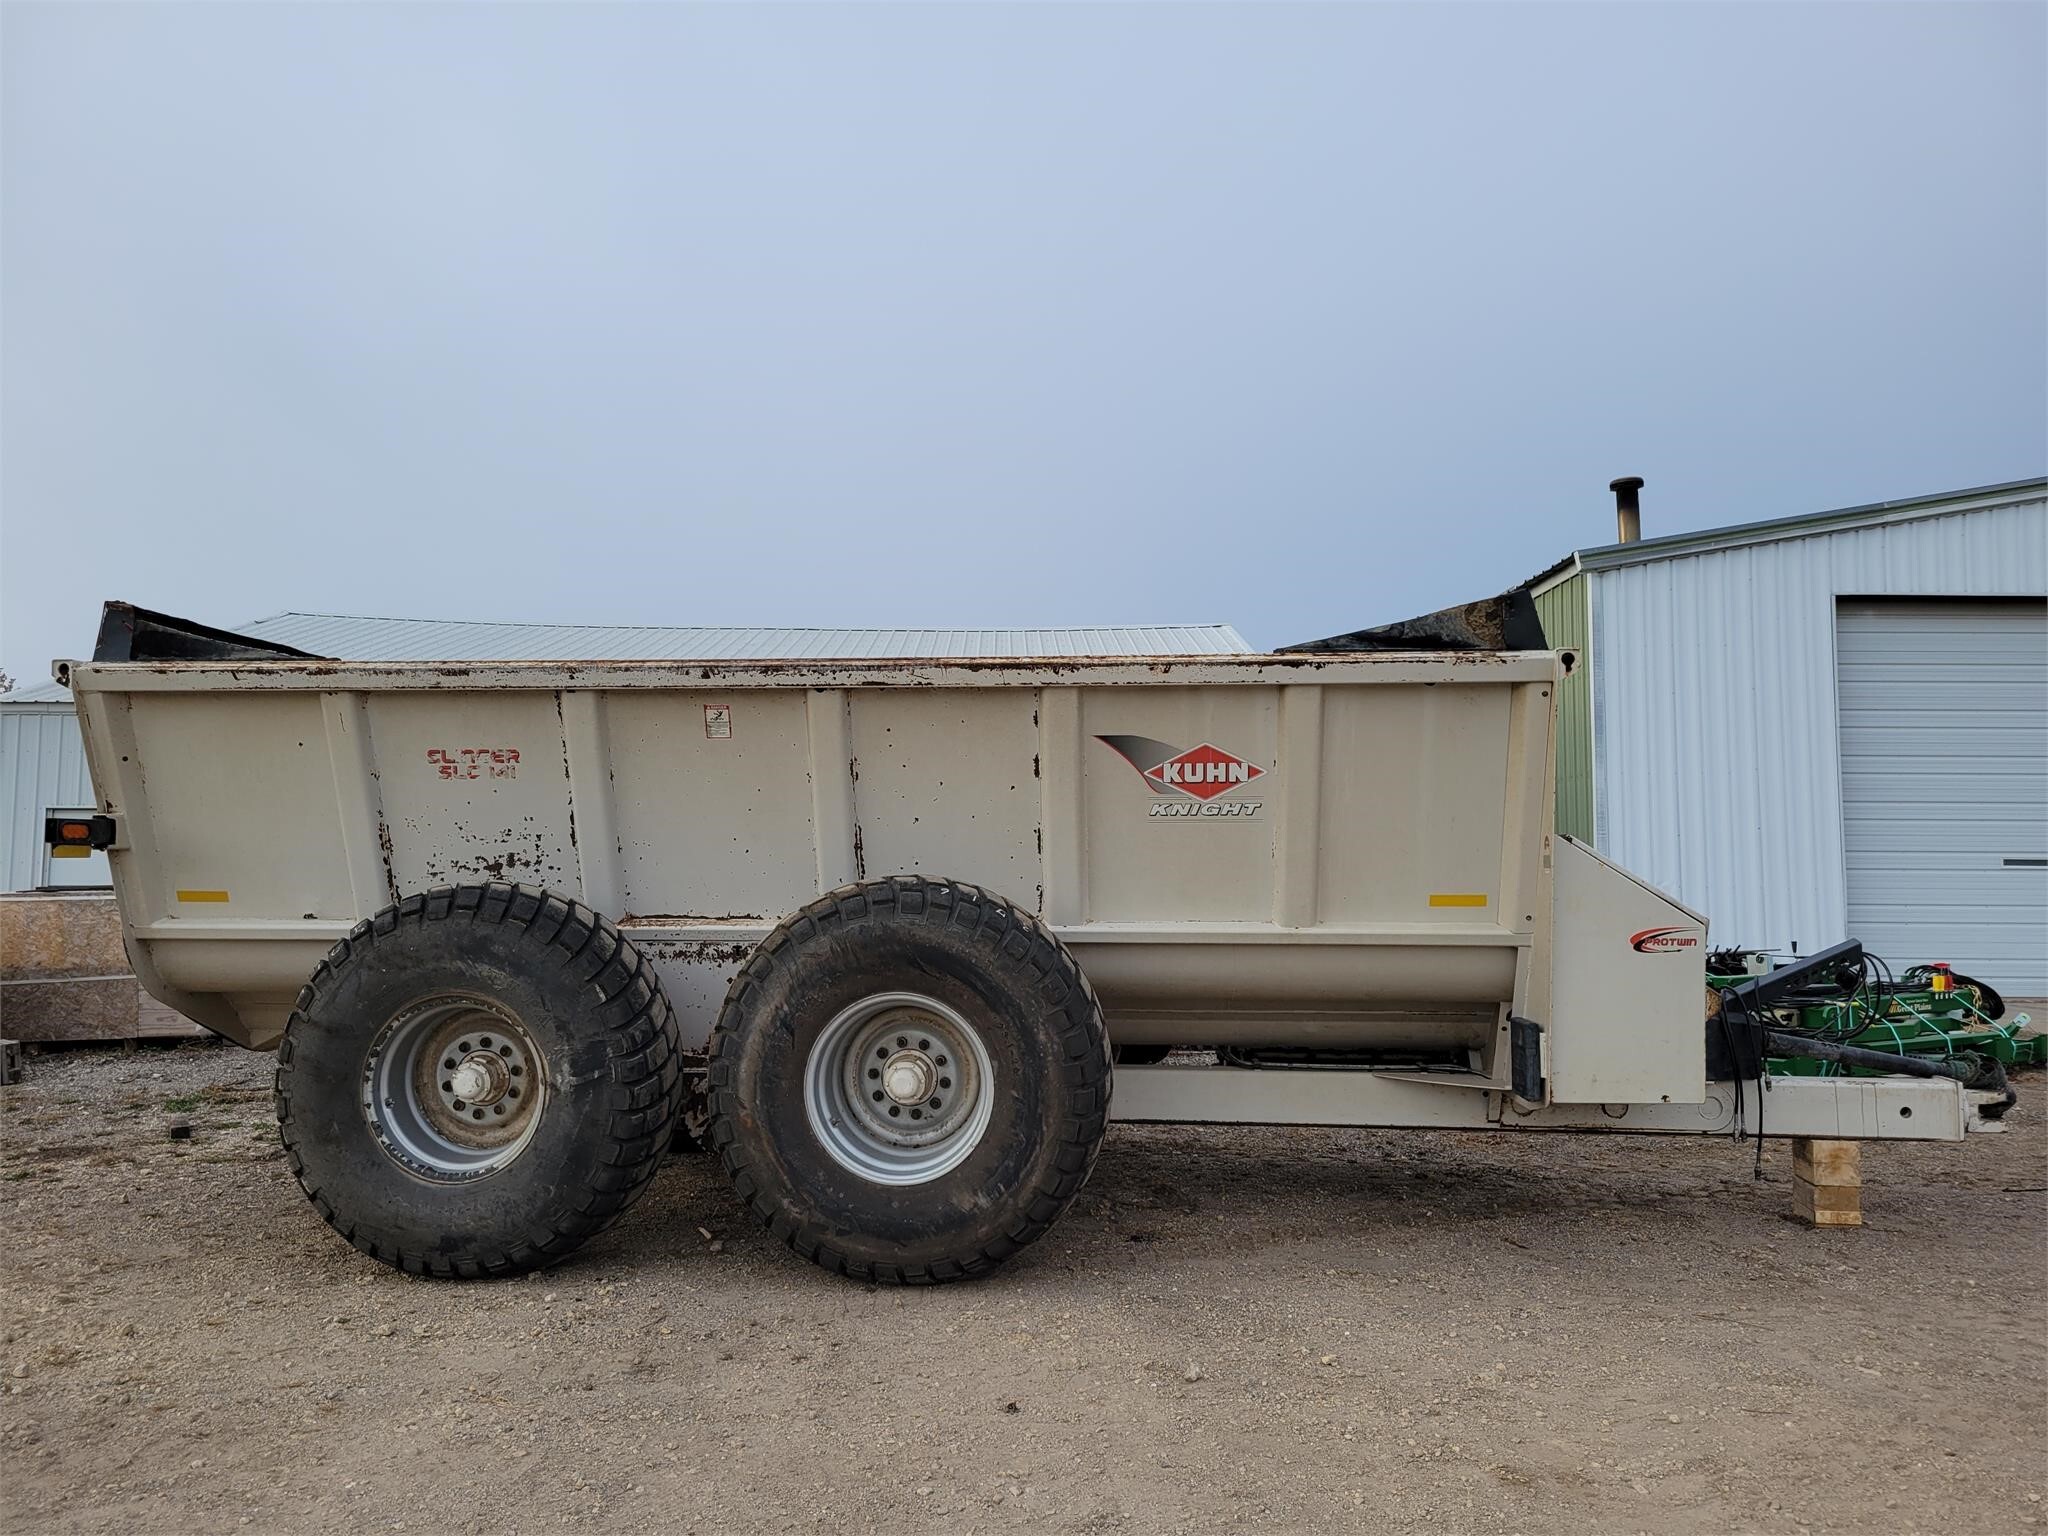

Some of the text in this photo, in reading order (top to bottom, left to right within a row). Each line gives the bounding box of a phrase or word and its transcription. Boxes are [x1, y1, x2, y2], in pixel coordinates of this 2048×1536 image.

[426, 749, 520, 764] SLNER
[1163, 762, 1249, 784] KUHN
[1149, 803, 1262, 817] KNIGHT
[1914, 1003, 1932, 1011] Plains
